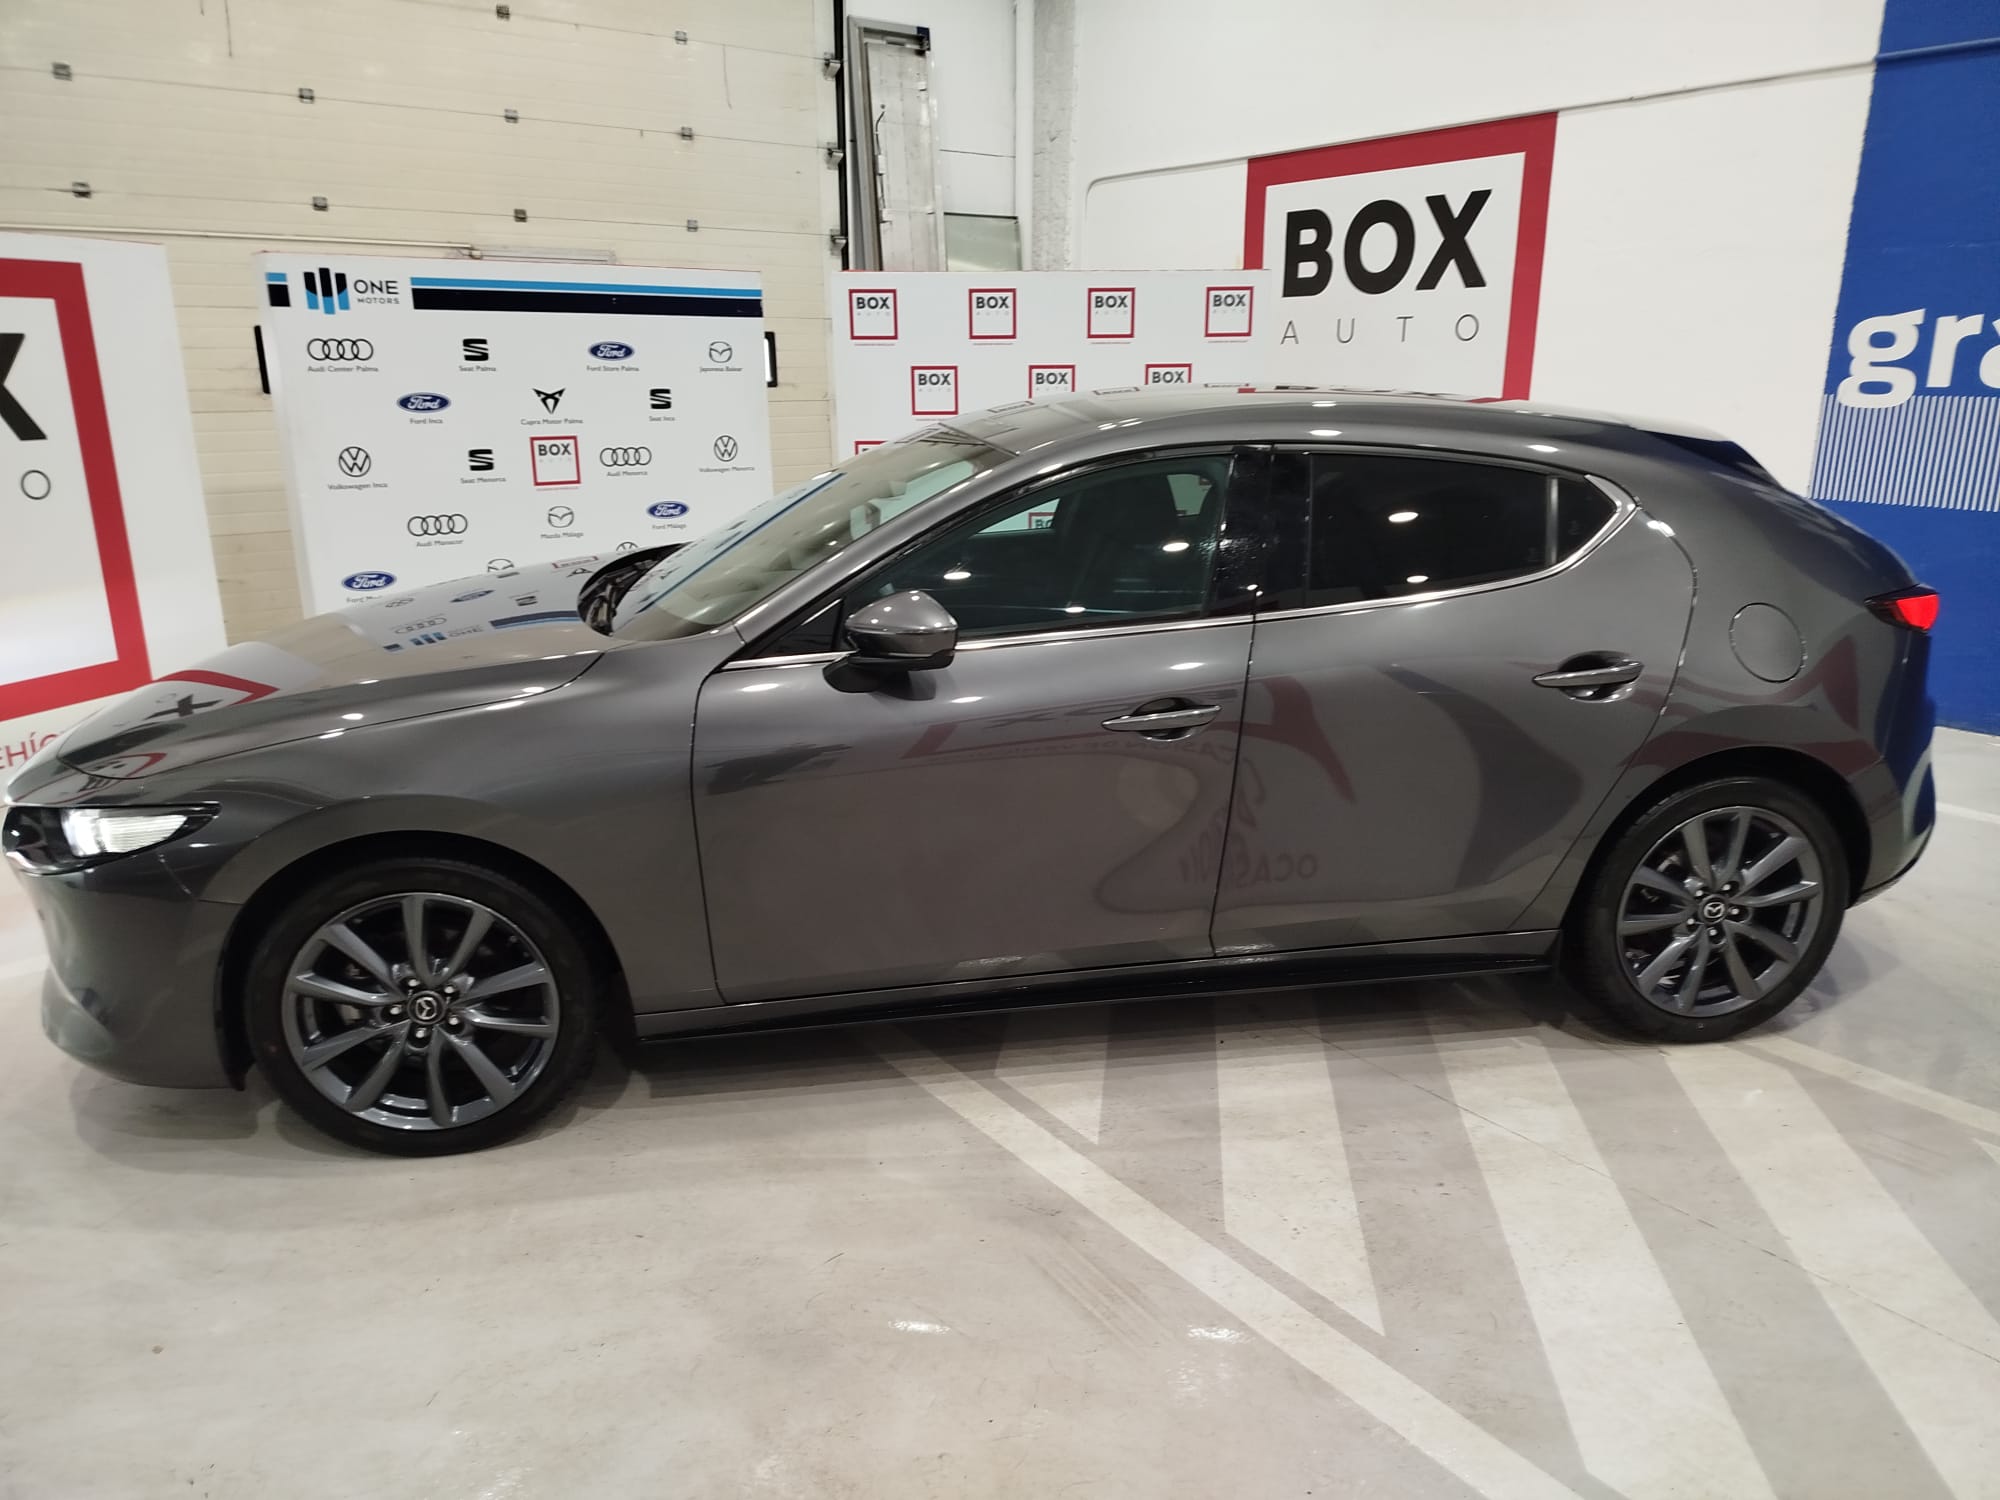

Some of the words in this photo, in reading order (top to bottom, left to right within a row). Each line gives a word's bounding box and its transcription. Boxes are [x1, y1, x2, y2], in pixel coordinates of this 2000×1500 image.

[1282, 189, 1492, 298] BOX
[354, 279, 399, 295] ONE
[856, 296, 890, 309] BOX
[976, 296, 1009, 309] BOX
[1095, 295, 1128, 308] BOX
[1213, 294, 1246, 307] BOX
[1281, 313, 1479, 345] AUTO
[597, 343, 626, 357] Ford
[918, 373, 951, 386] BOX
[1035, 372, 1068, 385] BOX
[1152, 371, 1185, 384] BOX
[407, 395, 441, 409] Ford
[538, 443, 571, 456] BOX
[655, 503, 682, 516] Ford
[1035, 518, 1053, 529] BO
[352, 574, 386, 588] Ford
